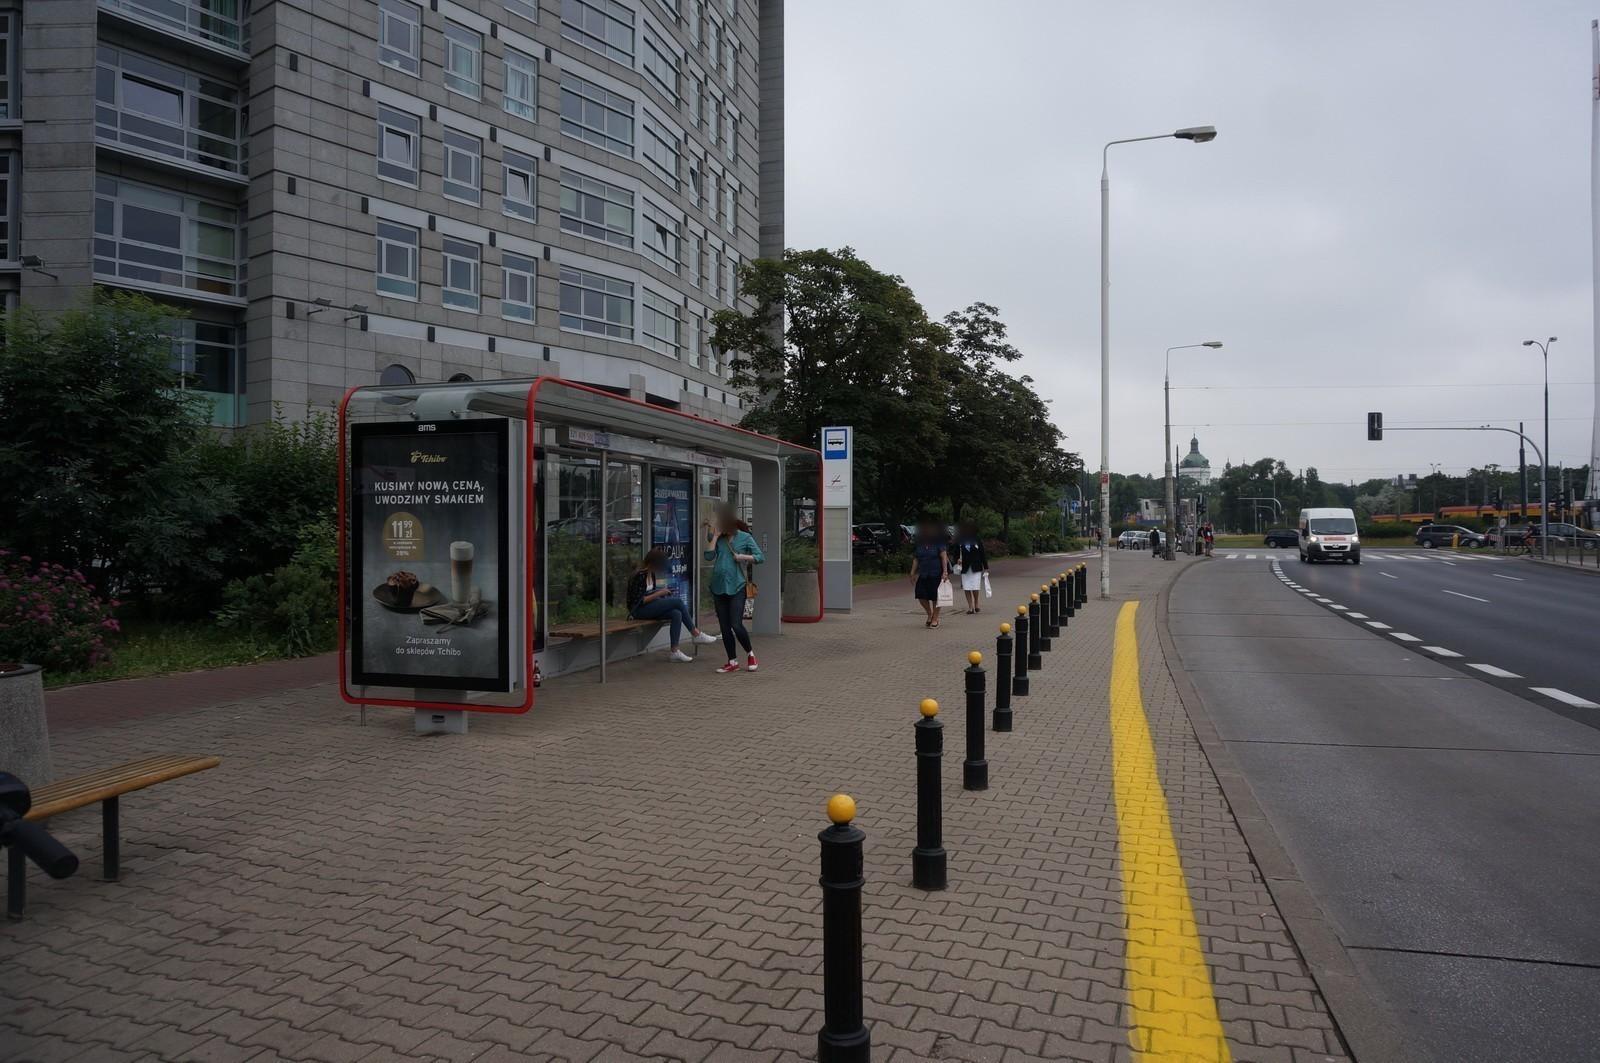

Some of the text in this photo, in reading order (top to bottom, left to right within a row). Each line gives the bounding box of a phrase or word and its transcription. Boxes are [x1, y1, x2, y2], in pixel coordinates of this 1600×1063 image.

[418, 424, 436, 432] ams
[420, 454, 448, 463] Tchibo
[374, 480, 484, 493] KUSIMY NOWĄ CENĄ,
[375, 494, 484, 505] UWODZIMY SMAKIEM
[406, 636, 451, 646] Zapraszamy
[395, 647, 462, 656] do sklepów Tchibo
